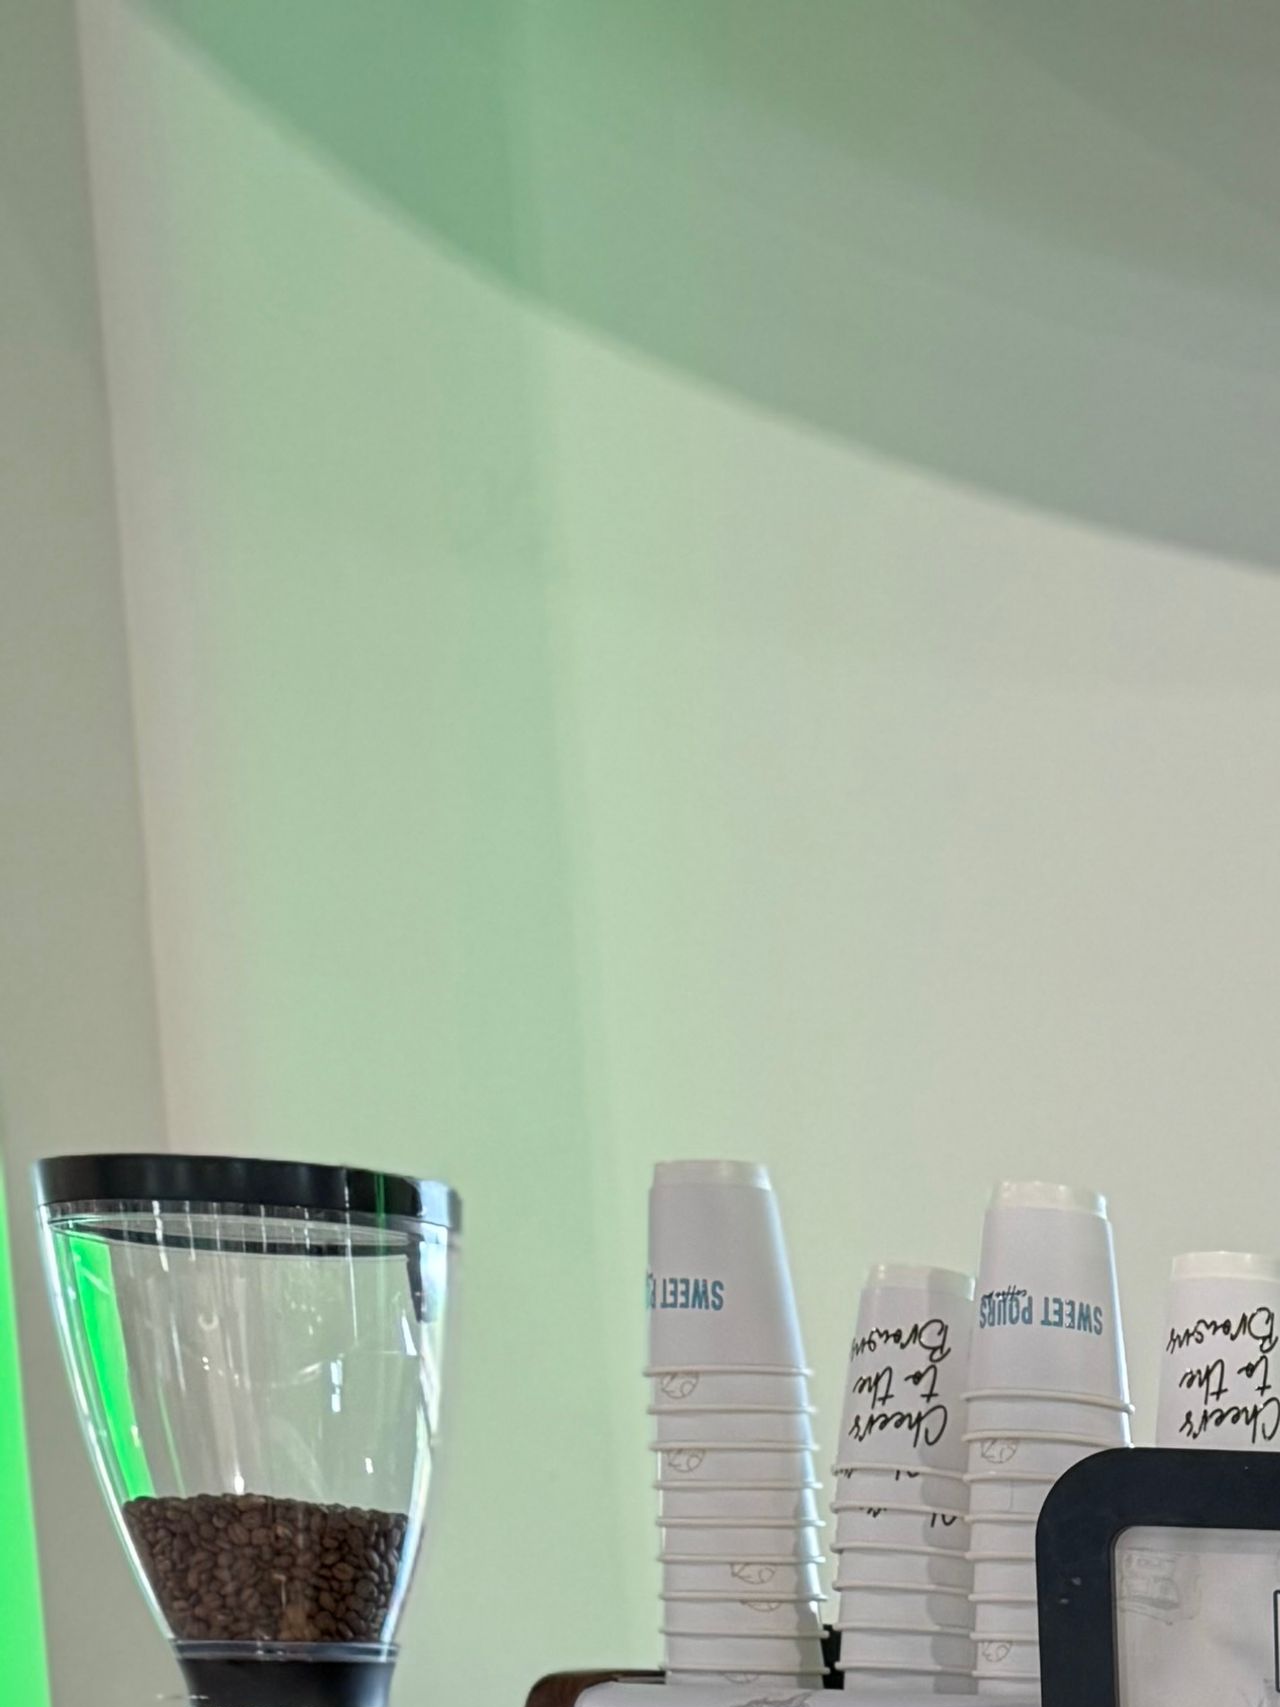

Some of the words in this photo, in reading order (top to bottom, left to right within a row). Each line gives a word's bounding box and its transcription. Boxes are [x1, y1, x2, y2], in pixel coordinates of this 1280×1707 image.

[660, 1278, 724, 1311] SWEET
[979, 1295, 1033, 1330] POURS
[1040, 1297, 1103, 1336] SWEET
[852, 1366, 895, 1410] the
[904, 1364, 939, 1404] to
[1178, 1359, 1228, 1406] the
[1237, 1355, 1271, 1397] to
[849, 1404, 948, 1449] Cheers
[1179, 1397, 1280, 1444] Cheers
